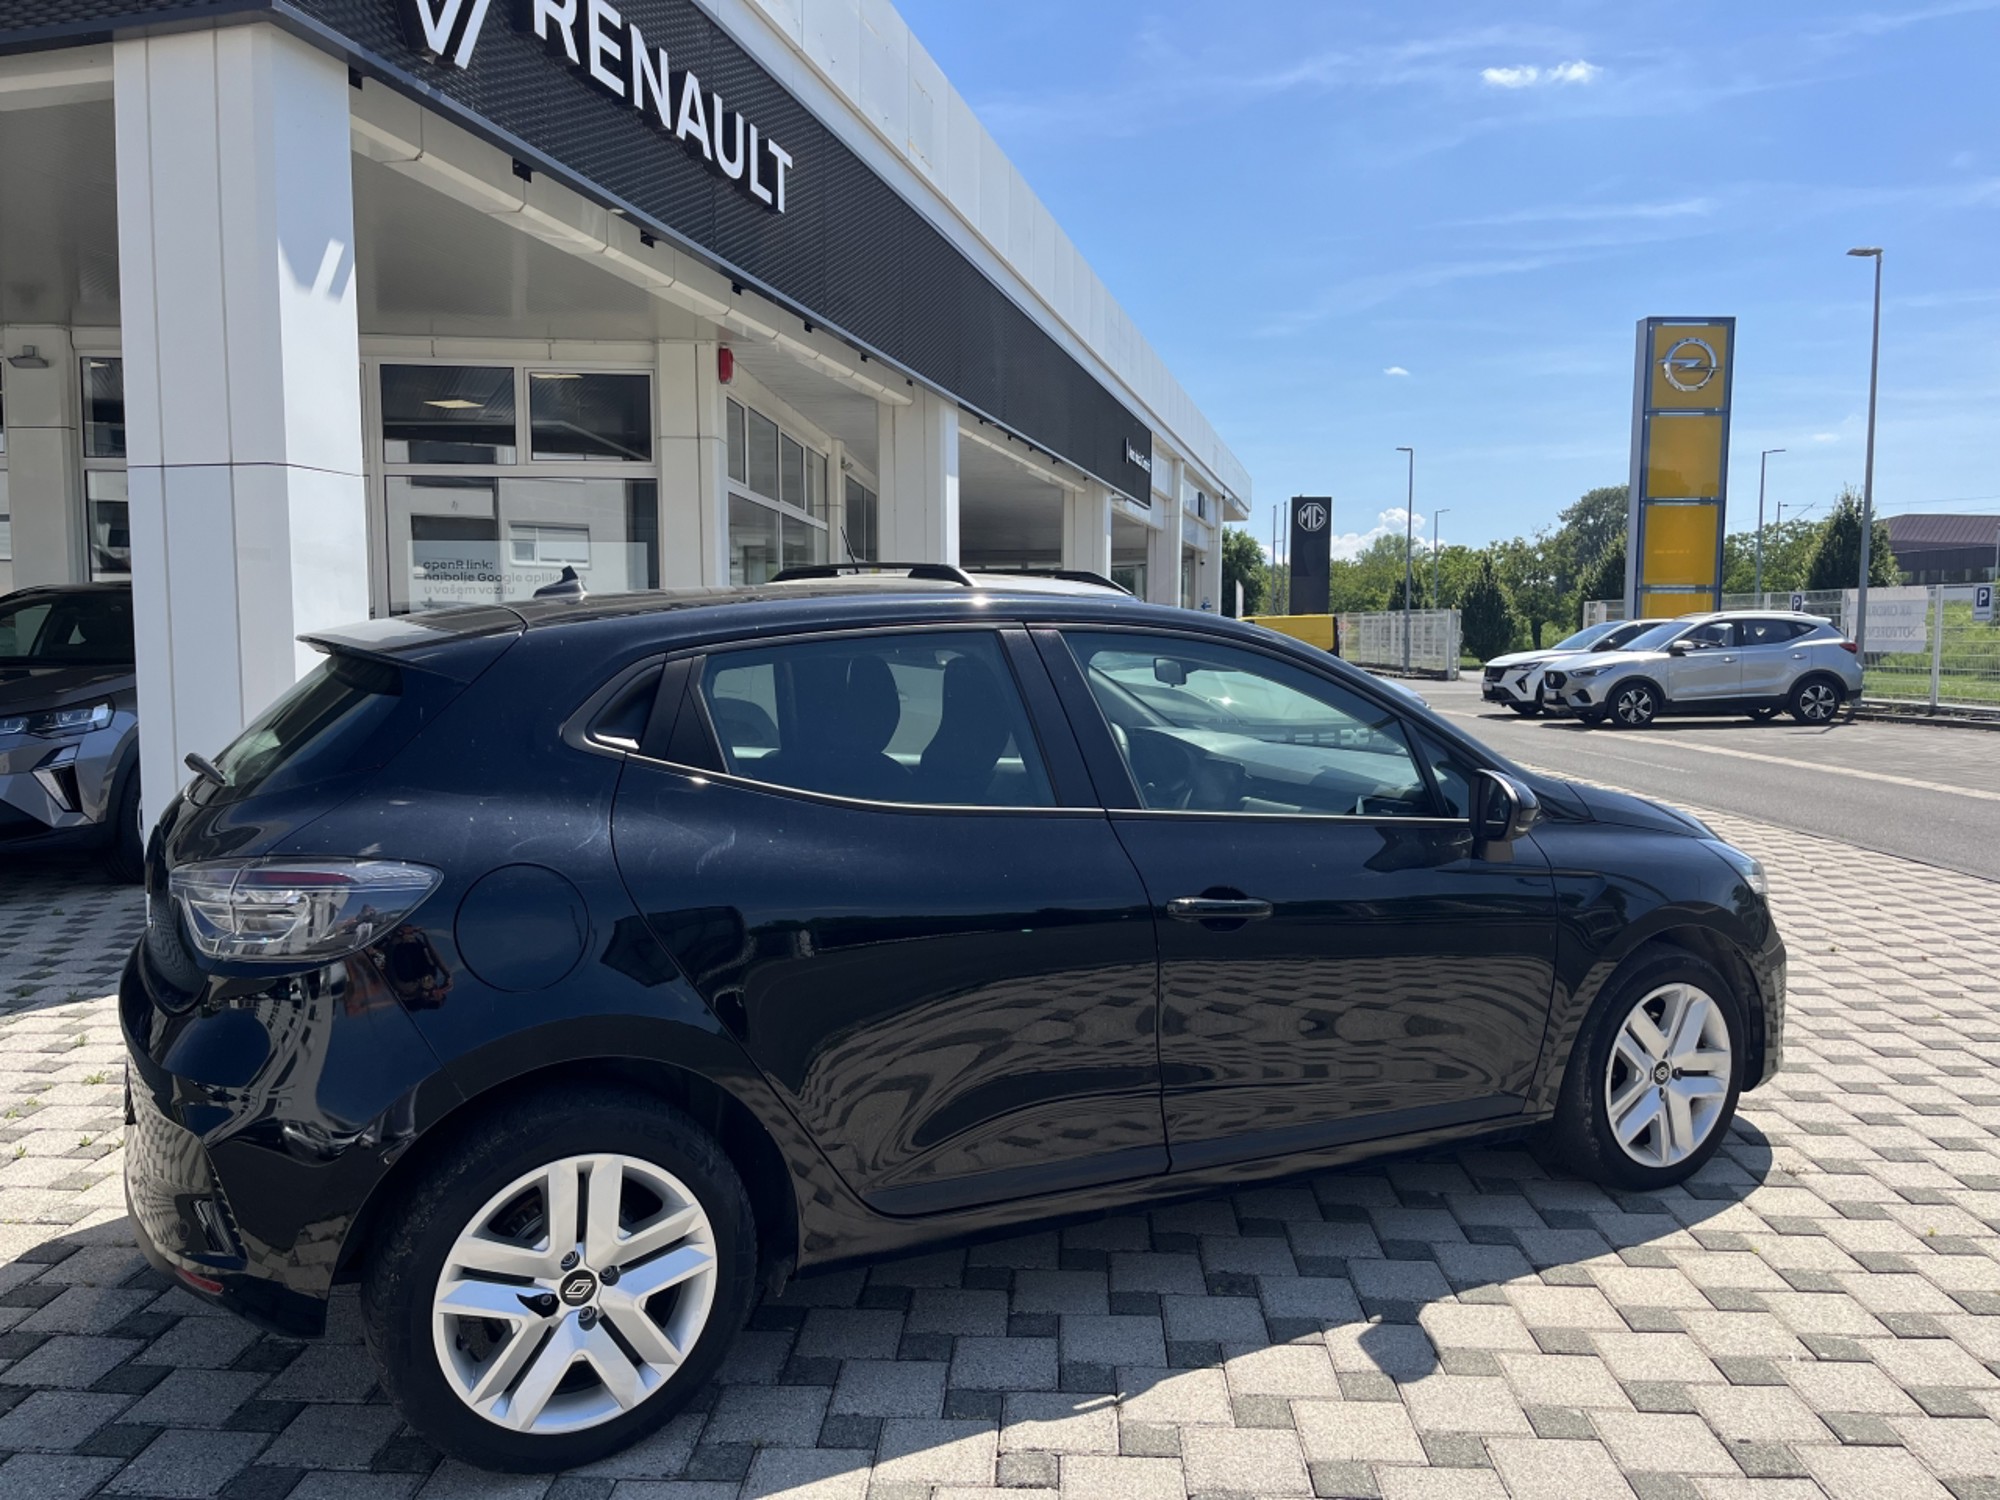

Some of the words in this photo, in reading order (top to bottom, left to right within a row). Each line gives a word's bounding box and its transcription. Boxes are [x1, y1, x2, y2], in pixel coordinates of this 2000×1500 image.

[534, 0, 793, 214] RENAULT
[1300, 505, 1325, 529] MG
[466, 559, 493, 570] link:
[477, 573, 523, 585] Google
[424, 586, 431, 595] u
[1978, 589, 1988, 605] P
[619, 1118, 717, 1177] NEXEN
